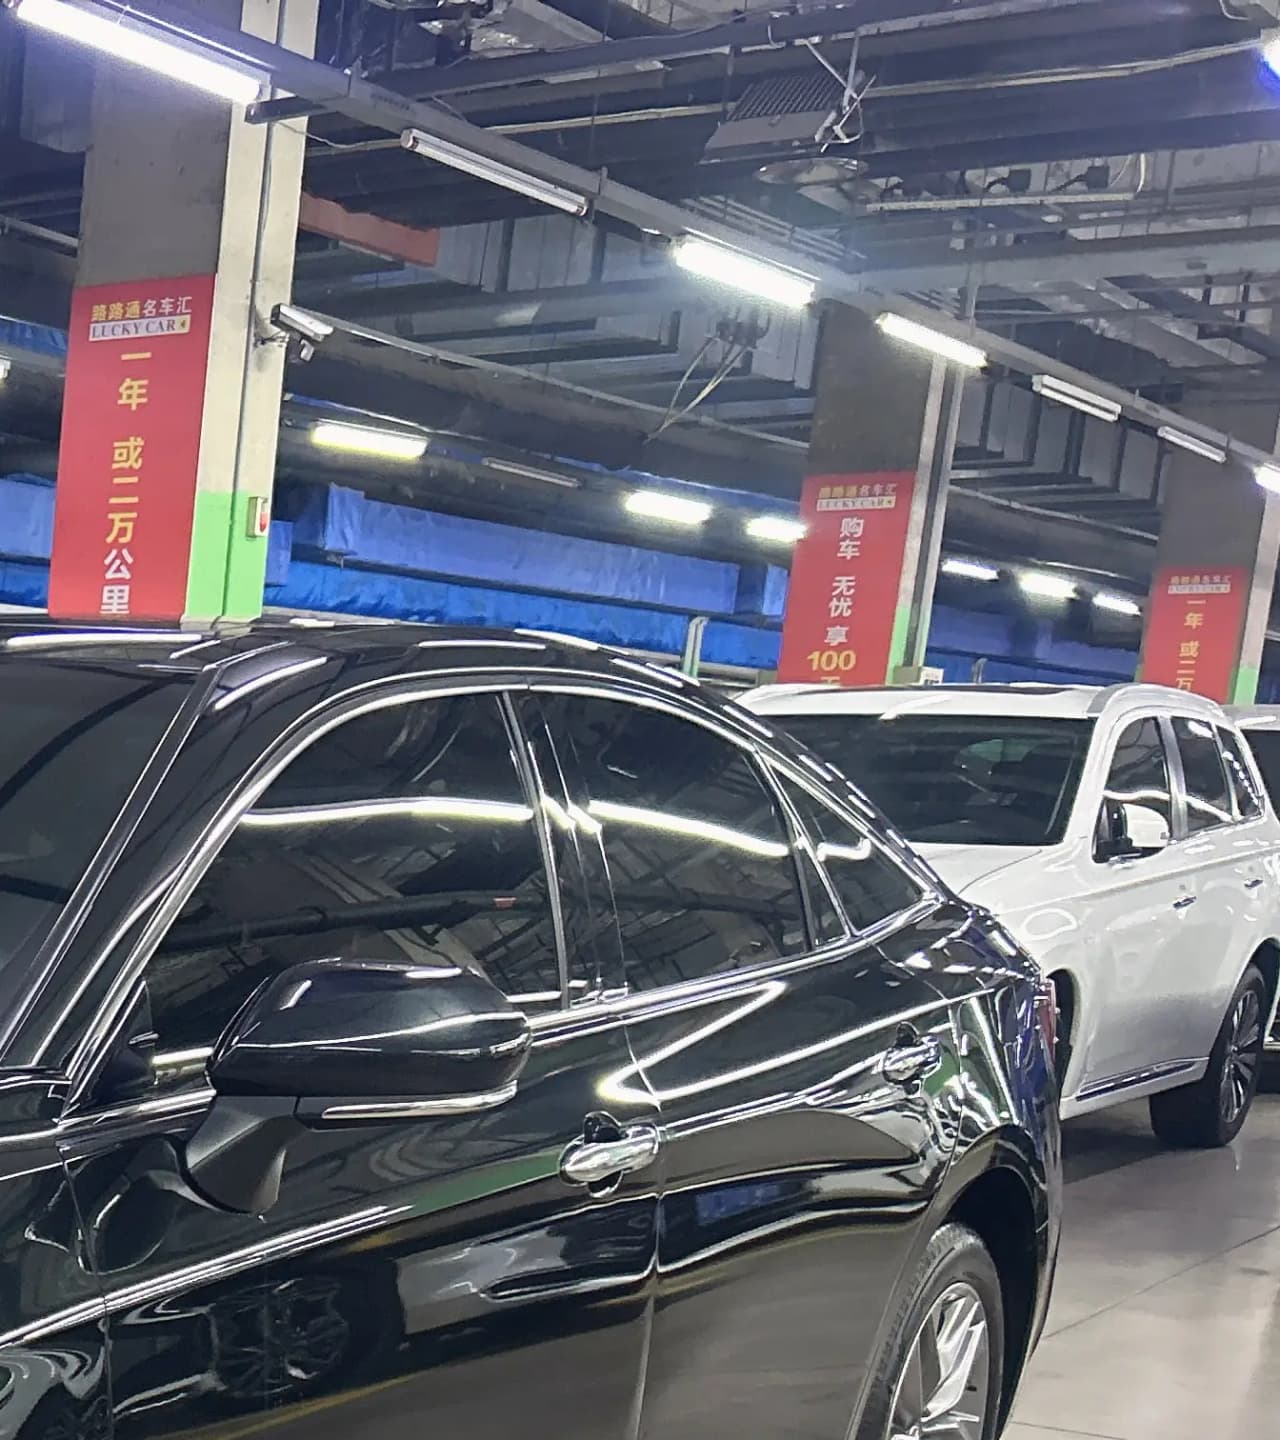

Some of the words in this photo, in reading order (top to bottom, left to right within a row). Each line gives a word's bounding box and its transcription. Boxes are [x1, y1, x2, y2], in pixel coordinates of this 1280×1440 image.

[91, 321, 141, 339] LUCKY
[145, 319, 176, 334] CAR
[837, 517, 864, 560] 购车
[828, 575, 856, 617] 无忧
[807, 650, 857, 671] 100
